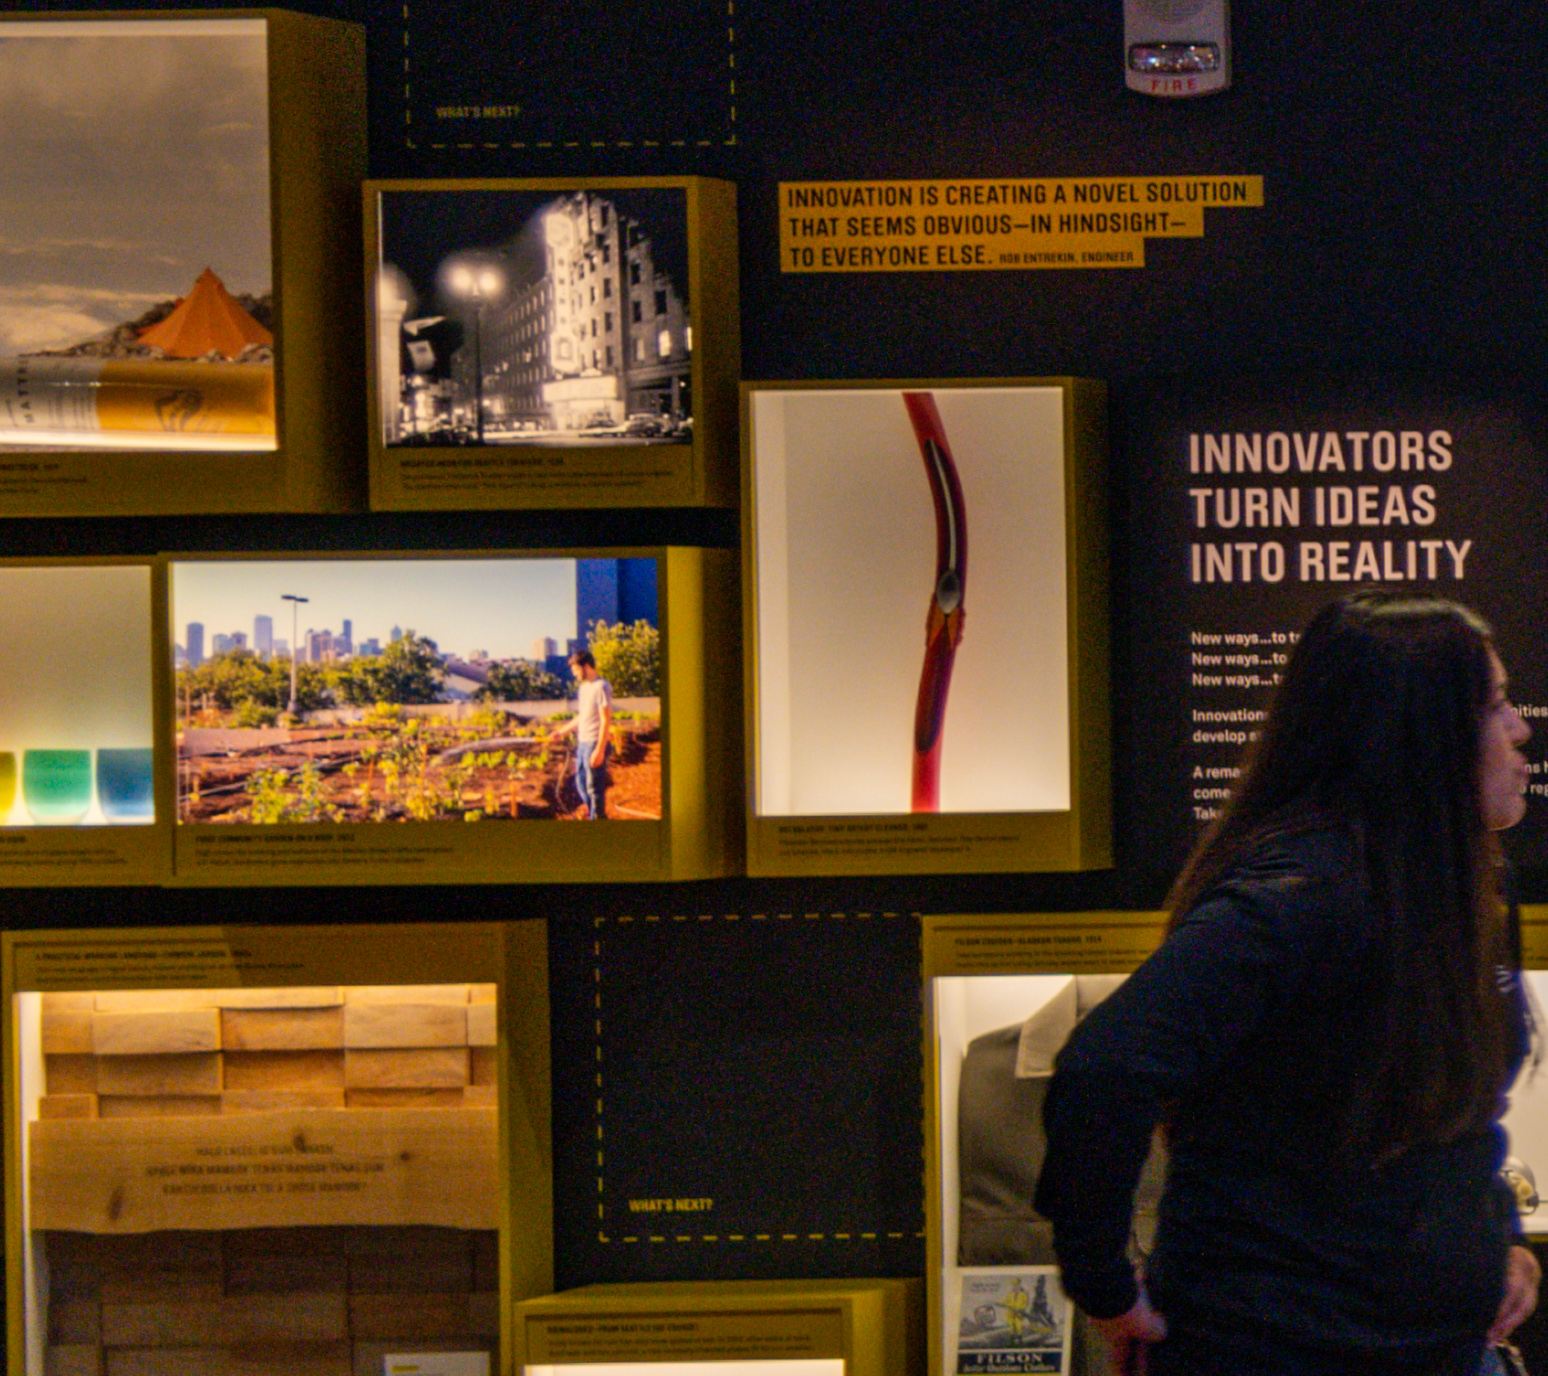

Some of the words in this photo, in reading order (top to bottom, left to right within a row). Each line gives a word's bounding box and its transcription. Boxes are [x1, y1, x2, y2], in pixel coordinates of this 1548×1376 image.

[1151, 78, 1198, 93] FIRE
[788, 187, 912, 206] INNOVATION
[919, 186, 939, 205] IS
[945, 185, 1046, 205] CREATING
[1054, 185, 1067, 203] A
[1074, 183, 1139, 203] NOVEL
[1146, 182, 1248, 203] SOLUTION
[791, 217, 841, 237] THAT
[847, 216, 917, 236] SEEMS
[791, 247, 815, 266] TO
[821, 246, 931, 266] EVERYONE
[936, 245, 992, 265] ELSE.
[1190, 430, 1453, 473] INNOVATORS
[1190, 488, 1300, 528] TURN
[1316, 485, 1437, 526] IDEAS
[1192, 544, 1285, 583] INTO
[1300, 540, 1473, 581] REALITY
[1192, 631, 1221, 645] New
[1192, 652, 1221, 666] New
[1192, 673, 1221, 687] New
[1193, 729, 1246, 745] develop
[1193, 766, 1202, 779] A
[629, 1197, 674, 1212] WHAT'S
[675, 1196, 713, 1211] NEXT?
[977, 1354, 1042, 1364] FILSON
